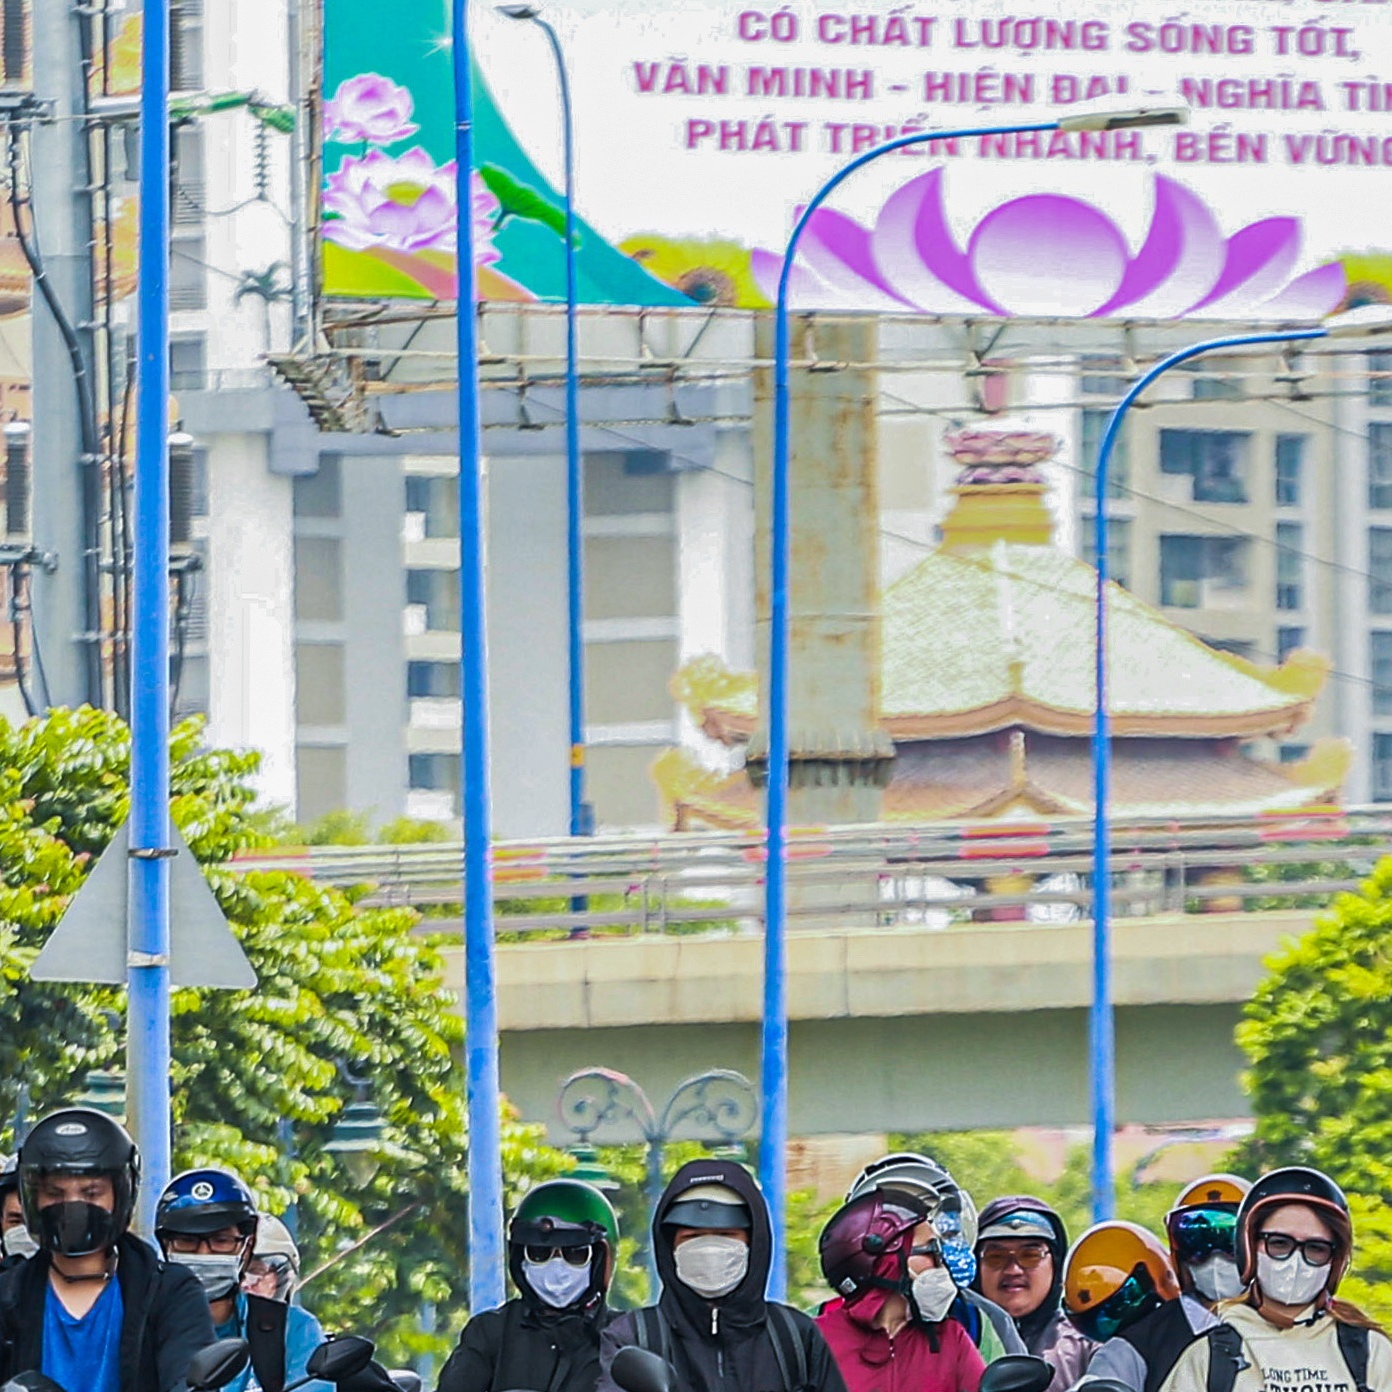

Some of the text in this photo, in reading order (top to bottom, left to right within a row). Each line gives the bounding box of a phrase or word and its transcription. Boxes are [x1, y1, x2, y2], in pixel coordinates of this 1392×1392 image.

[738, 5, 1362, 62] CÓ CHẤT LƯỢNG SỐNG TỐT,
[634, 56, 730, 95] VĂN
[746, 66, 875, 99] MINH
[924, 66, 1035, 111] HIỆN
[1180, 73, 1326, 110] NGHĨA
[686, 115, 808, 151] PHÁT
[1262, 1367, 1328, 1383] LONG TIME
